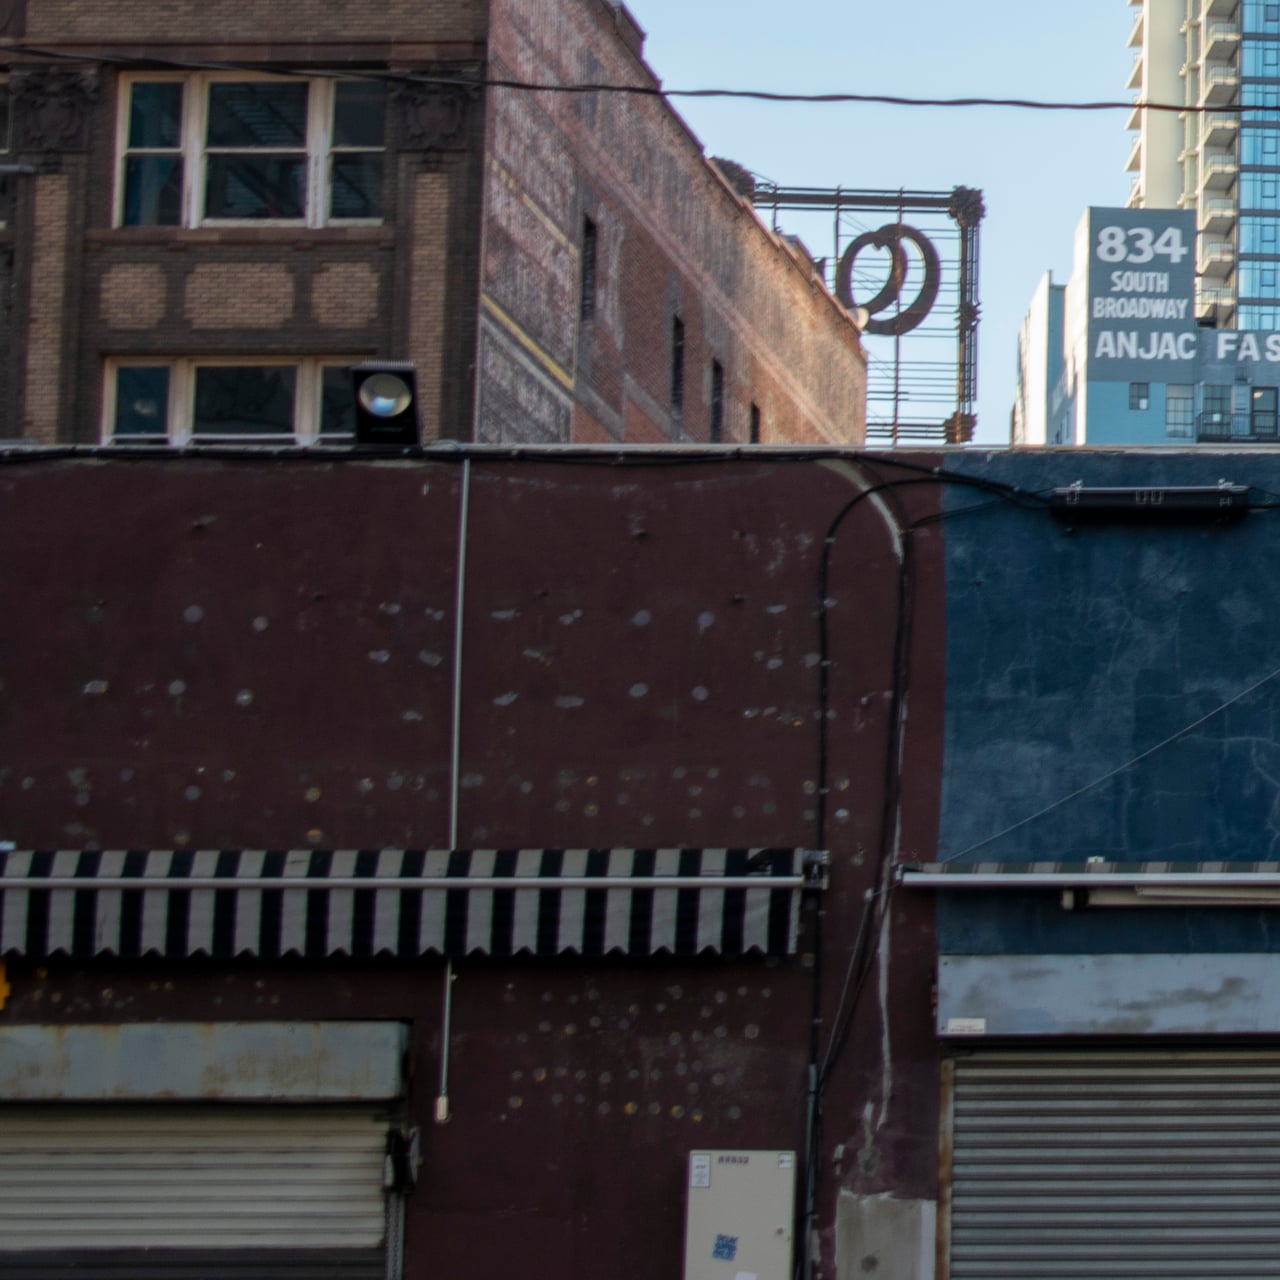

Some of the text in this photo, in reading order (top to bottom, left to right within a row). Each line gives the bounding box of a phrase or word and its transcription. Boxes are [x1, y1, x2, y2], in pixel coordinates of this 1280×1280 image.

[1096, 225, 1188, 264] 834
[1110, 270, 1169, 293] SOUTH
[1092, 296, 1189, 320] BROADWAY
[1094, 330, 1197, 361] ANJAC
